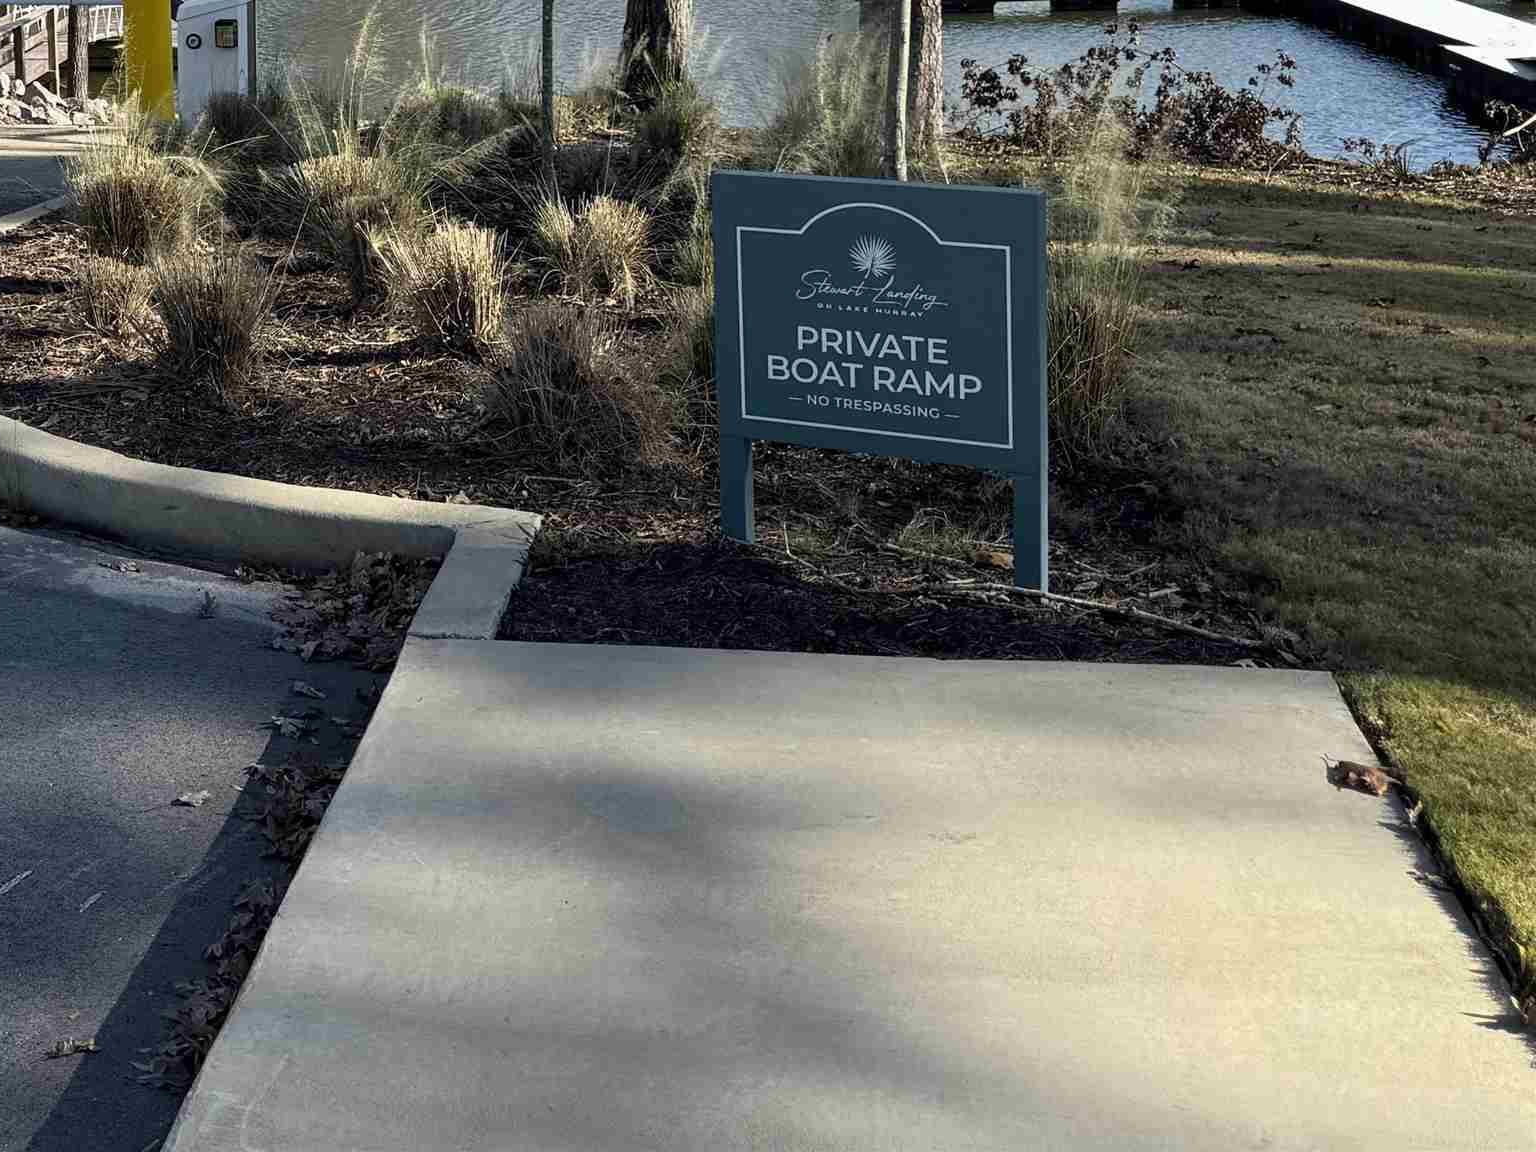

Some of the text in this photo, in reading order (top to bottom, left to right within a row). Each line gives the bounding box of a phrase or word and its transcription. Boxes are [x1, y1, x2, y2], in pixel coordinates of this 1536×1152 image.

[796, 269, 949, 310] Stewart Landing
[875, 308, 924, 317] MURRAY
[797, 326, 948, 364] PRIVATE
[767, 355, 982, 399] BOAT RAMP
[807, 394, 940, 419] NO TRESPASSING
